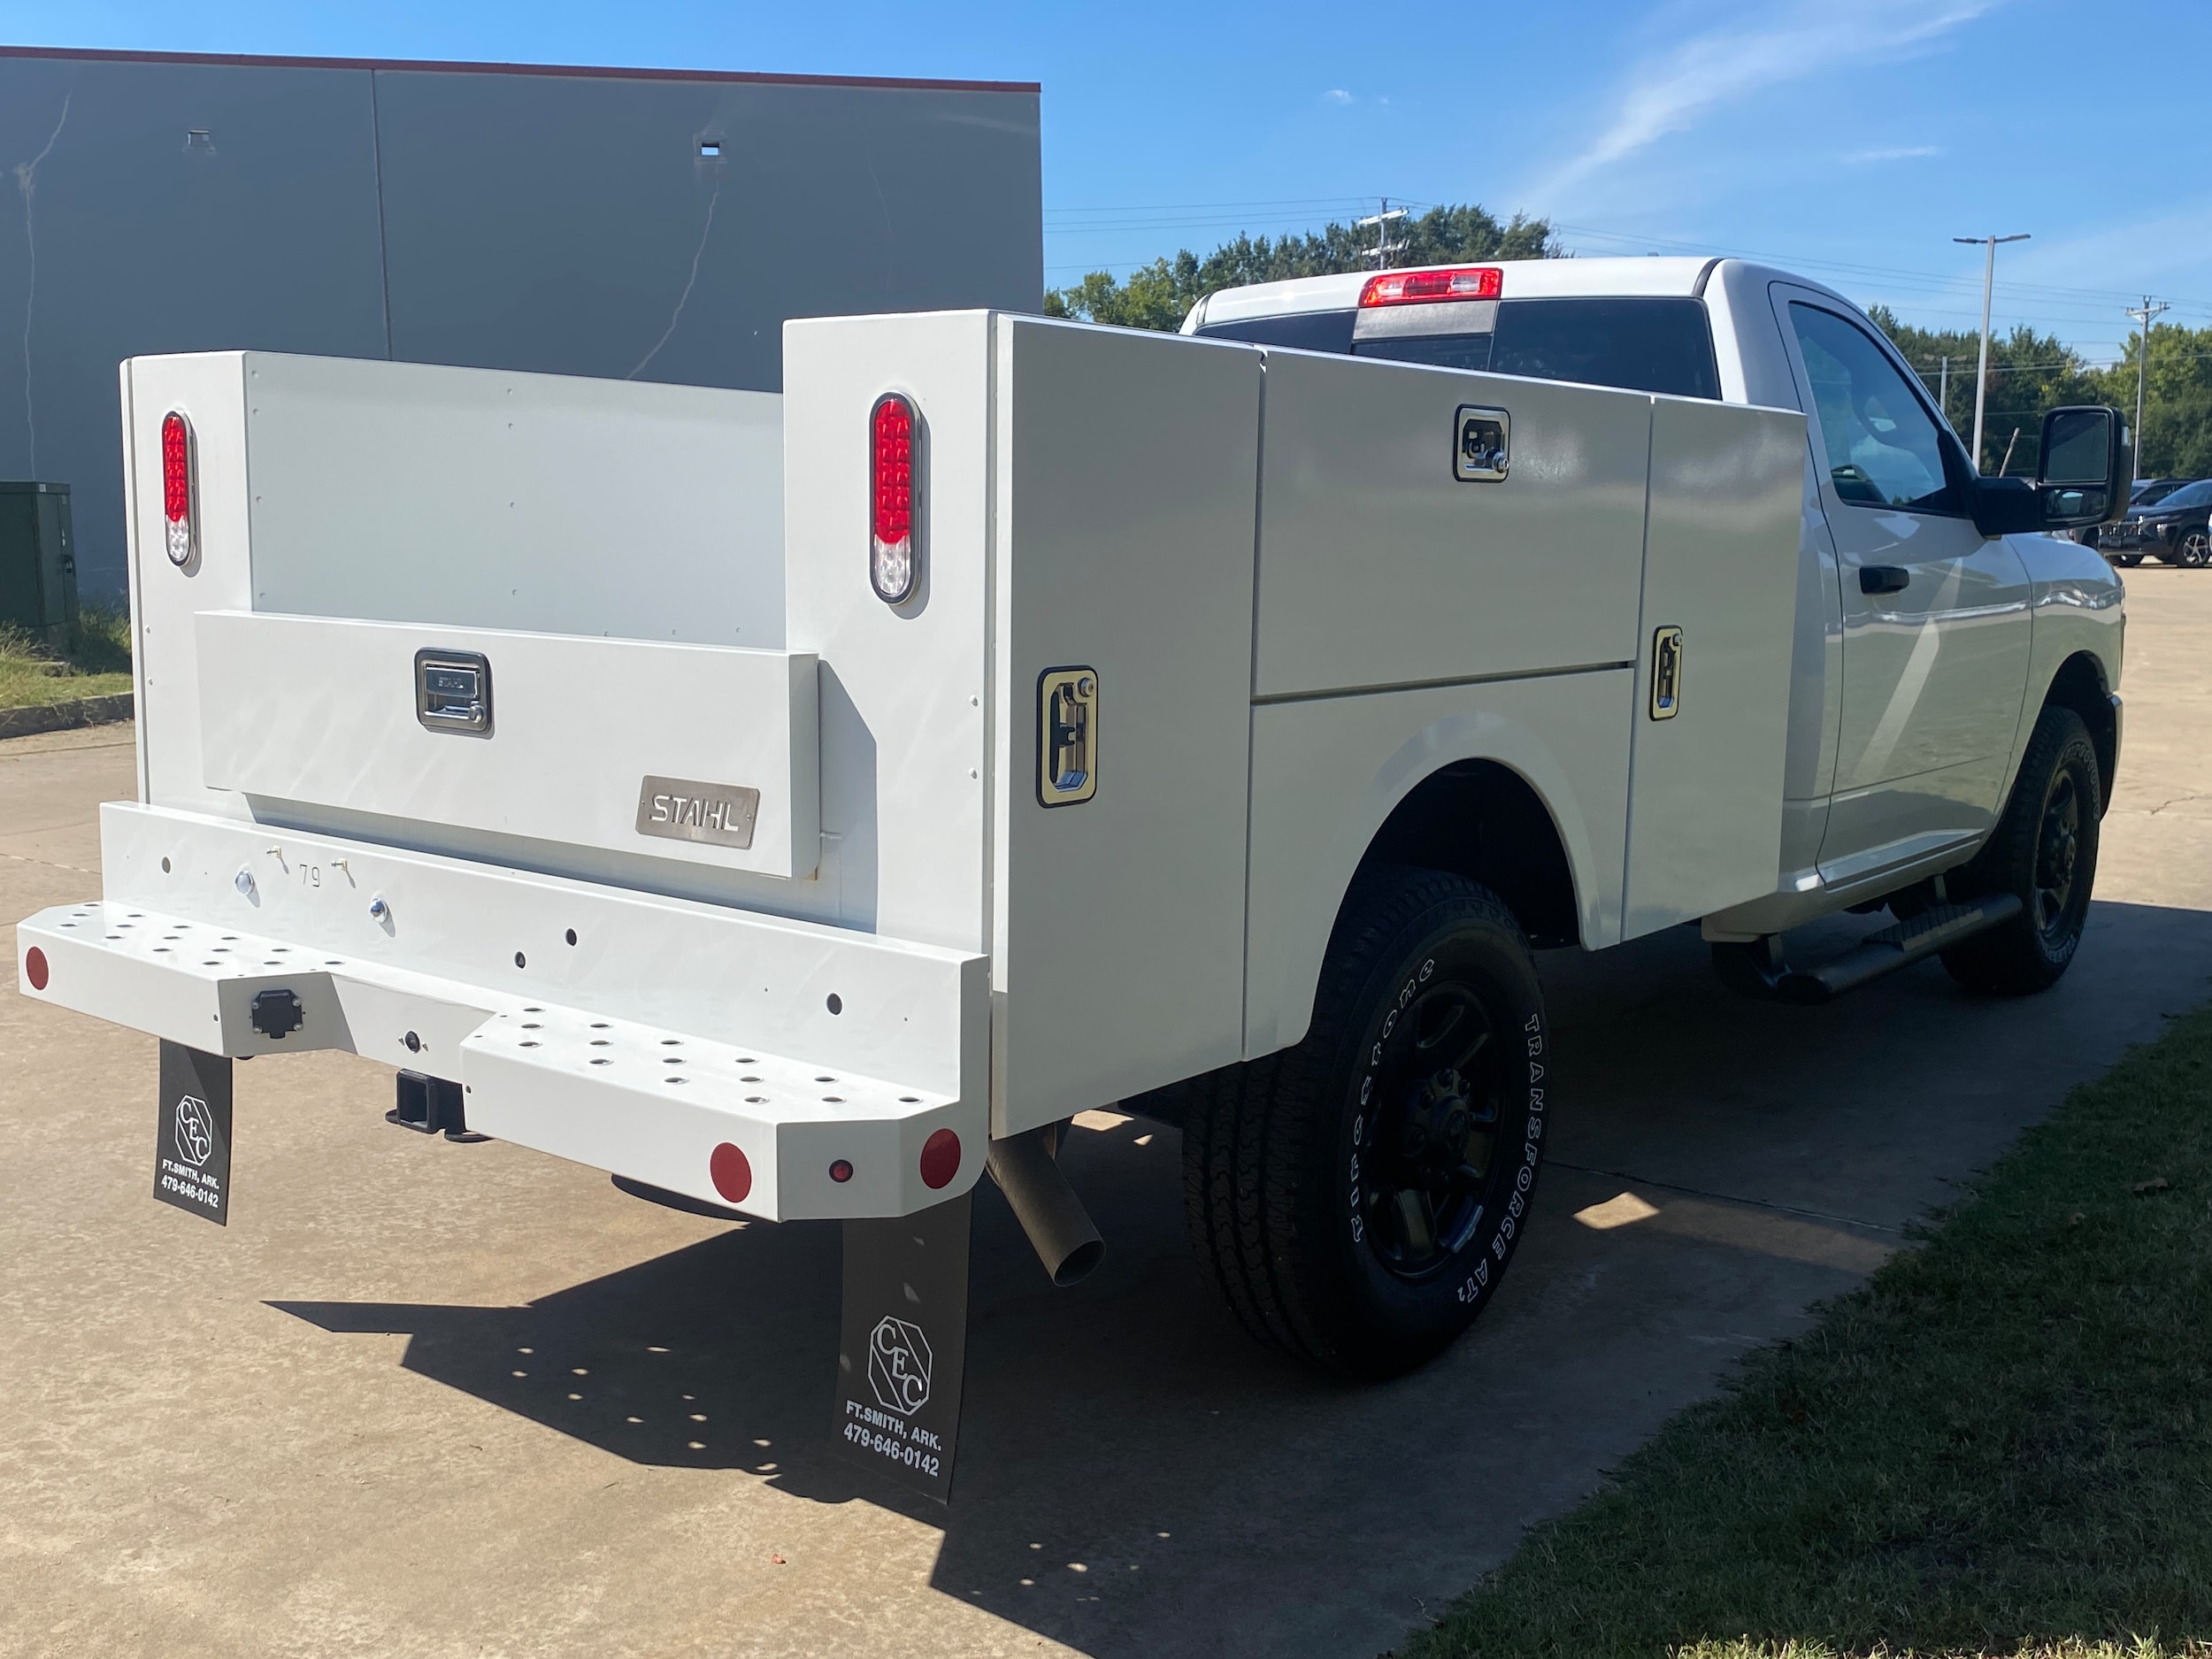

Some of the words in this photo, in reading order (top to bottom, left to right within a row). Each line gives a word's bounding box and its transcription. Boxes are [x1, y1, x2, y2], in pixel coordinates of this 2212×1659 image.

[649, 792, 739, 832] STAHL
[299, 864, 320, 887] 79
[179, 1101, 208, 1160] CEC
[1492, 1012, 1544, 1261] TRANSFORCE
[161, 1174, 219, 1209] 479-646-0142
[201, 1172, 220, 1190] ARK.
[876, 1323, 923, 1408] CEC
[843, 1421, 940, 1478] 479-646-0142
[910, 1425, 942, 1452] ARK.
